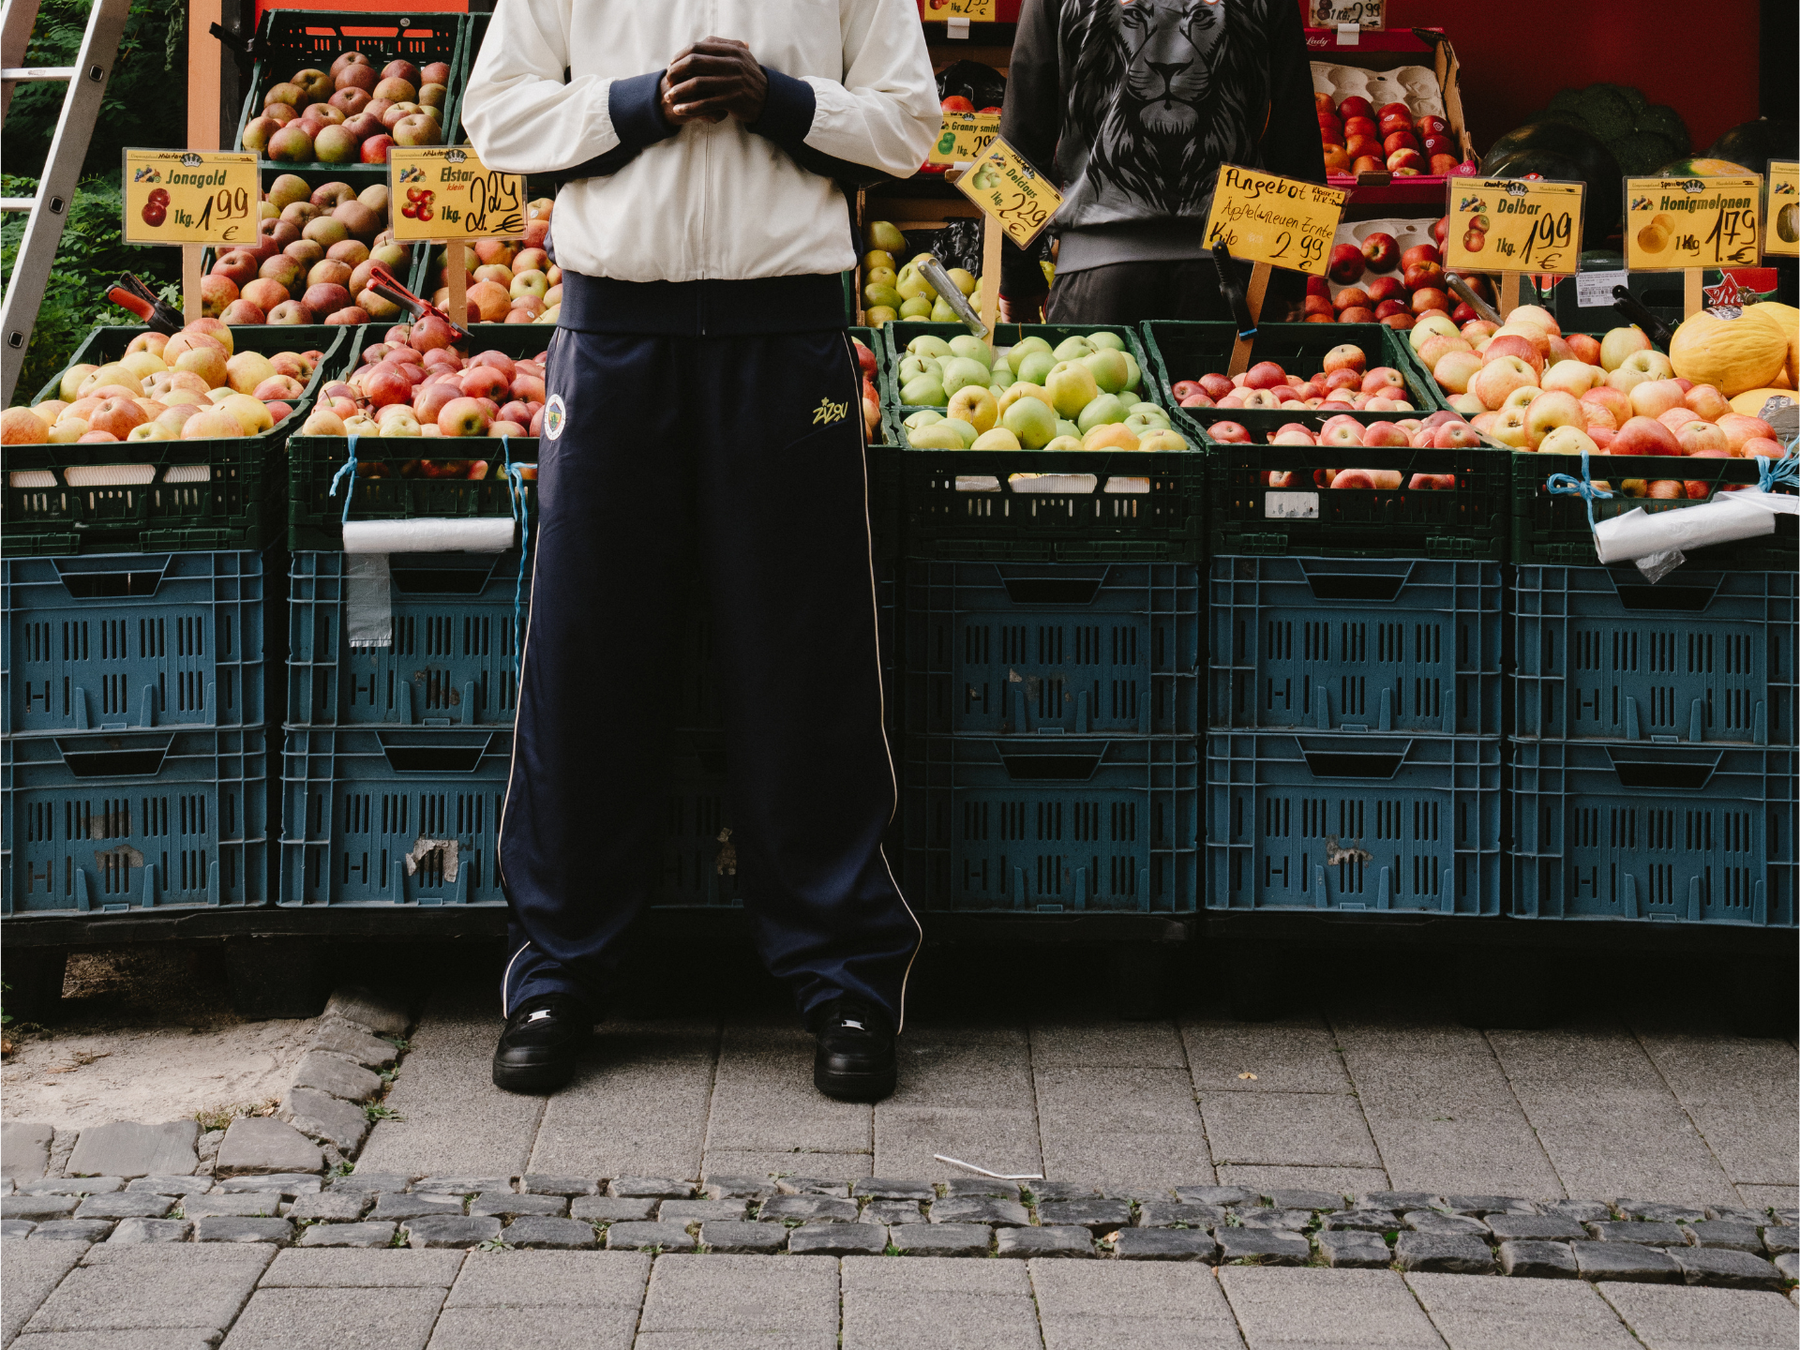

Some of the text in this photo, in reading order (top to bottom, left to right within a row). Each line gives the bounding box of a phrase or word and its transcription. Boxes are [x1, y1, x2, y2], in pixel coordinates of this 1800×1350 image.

[1306, 37, 1328, 47] Lady
[952, 122, 978, 134] Granny
[165, 169, 227, 188] Jonagold
[440, 166, 475, 182] Elstar
[446, 183, 464, 191] klein
[1006, 168, 1038, 199] Delcious
[1225, 168, 1306, 199] Angebot
[990, 191, 1003, 206] 1kg.
[1497, 198, 1541, 215] Delbar
[1660, 193, 1752, 213] Honigmelonen
[174, 209, 194, 227] 1kg.
[441, 205, 461, 223] 1kg.
[1221, 197, 1259, 222] Äpfel
[1302, 216, 1333, 239] Ernte
[222, 226, 239, 240] €
[1209, 221, 1238, 246] Kilo
[1496, 238, 1516, 256] 1kg.
[1537, 253, 1562, 269] €
